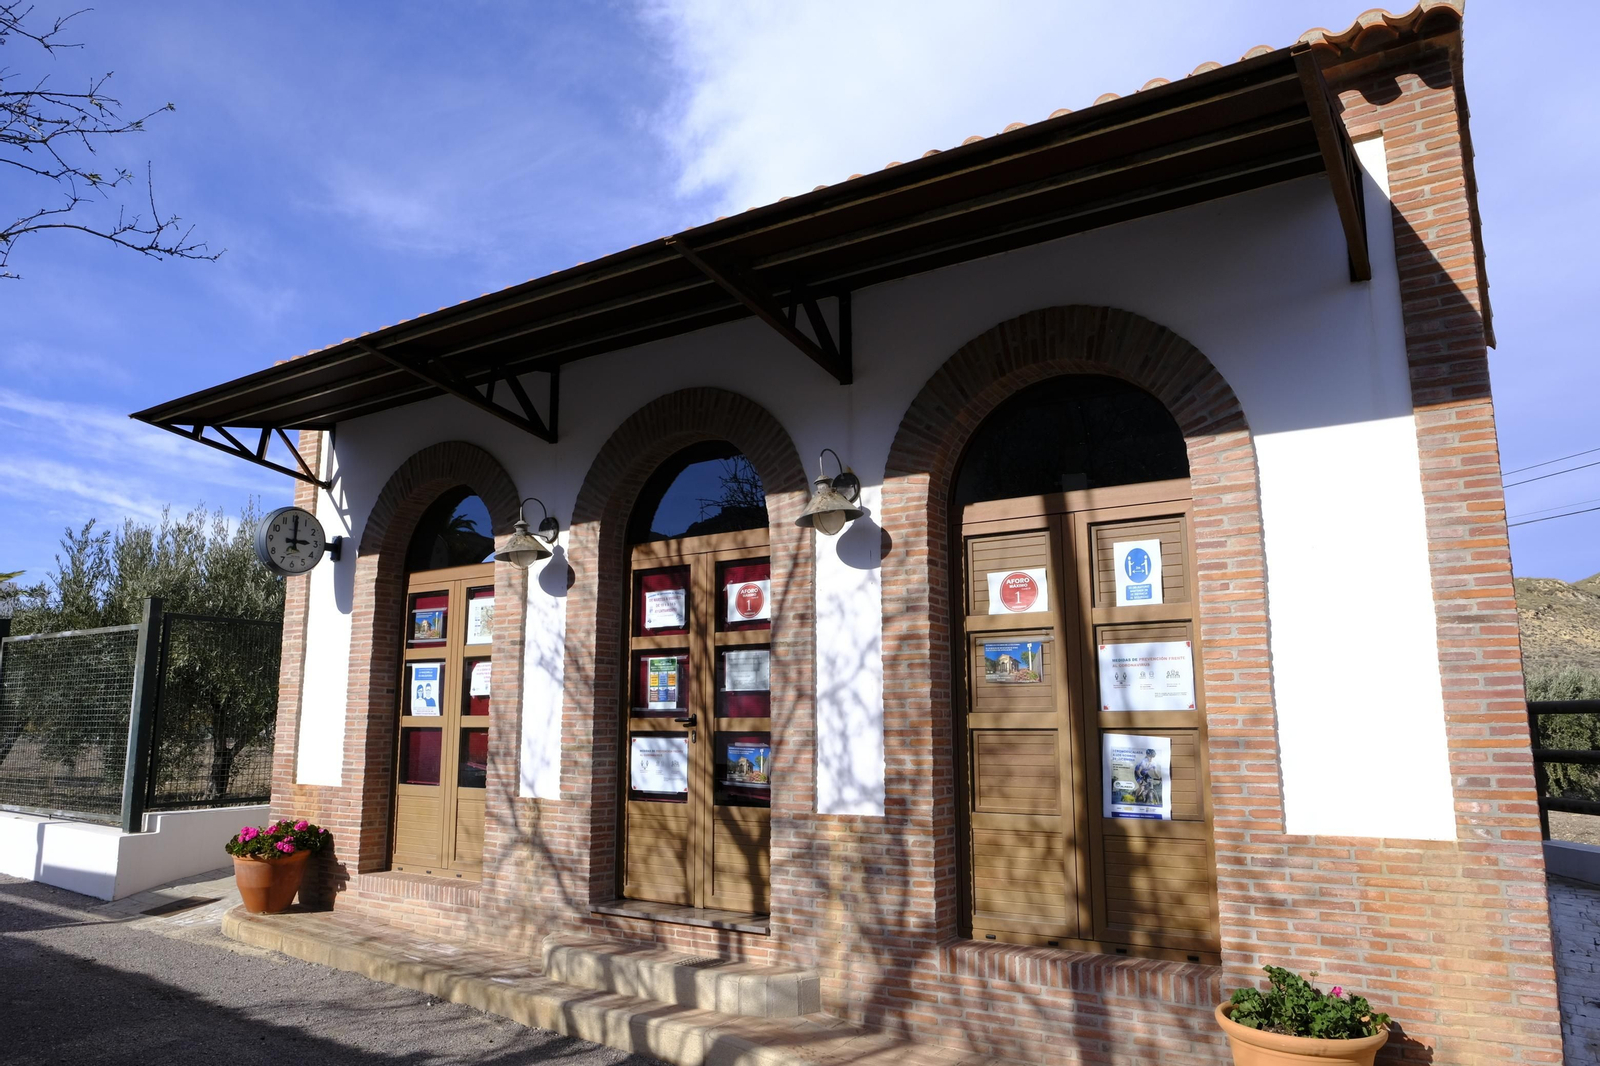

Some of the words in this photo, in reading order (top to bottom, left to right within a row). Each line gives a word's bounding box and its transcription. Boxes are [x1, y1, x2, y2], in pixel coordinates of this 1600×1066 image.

[293, 515, 299, 523] 1
[273, 524, 280, 532] 10
[1015, 591, 1022, 604] 1
[746, 600, 751, 611] 1
